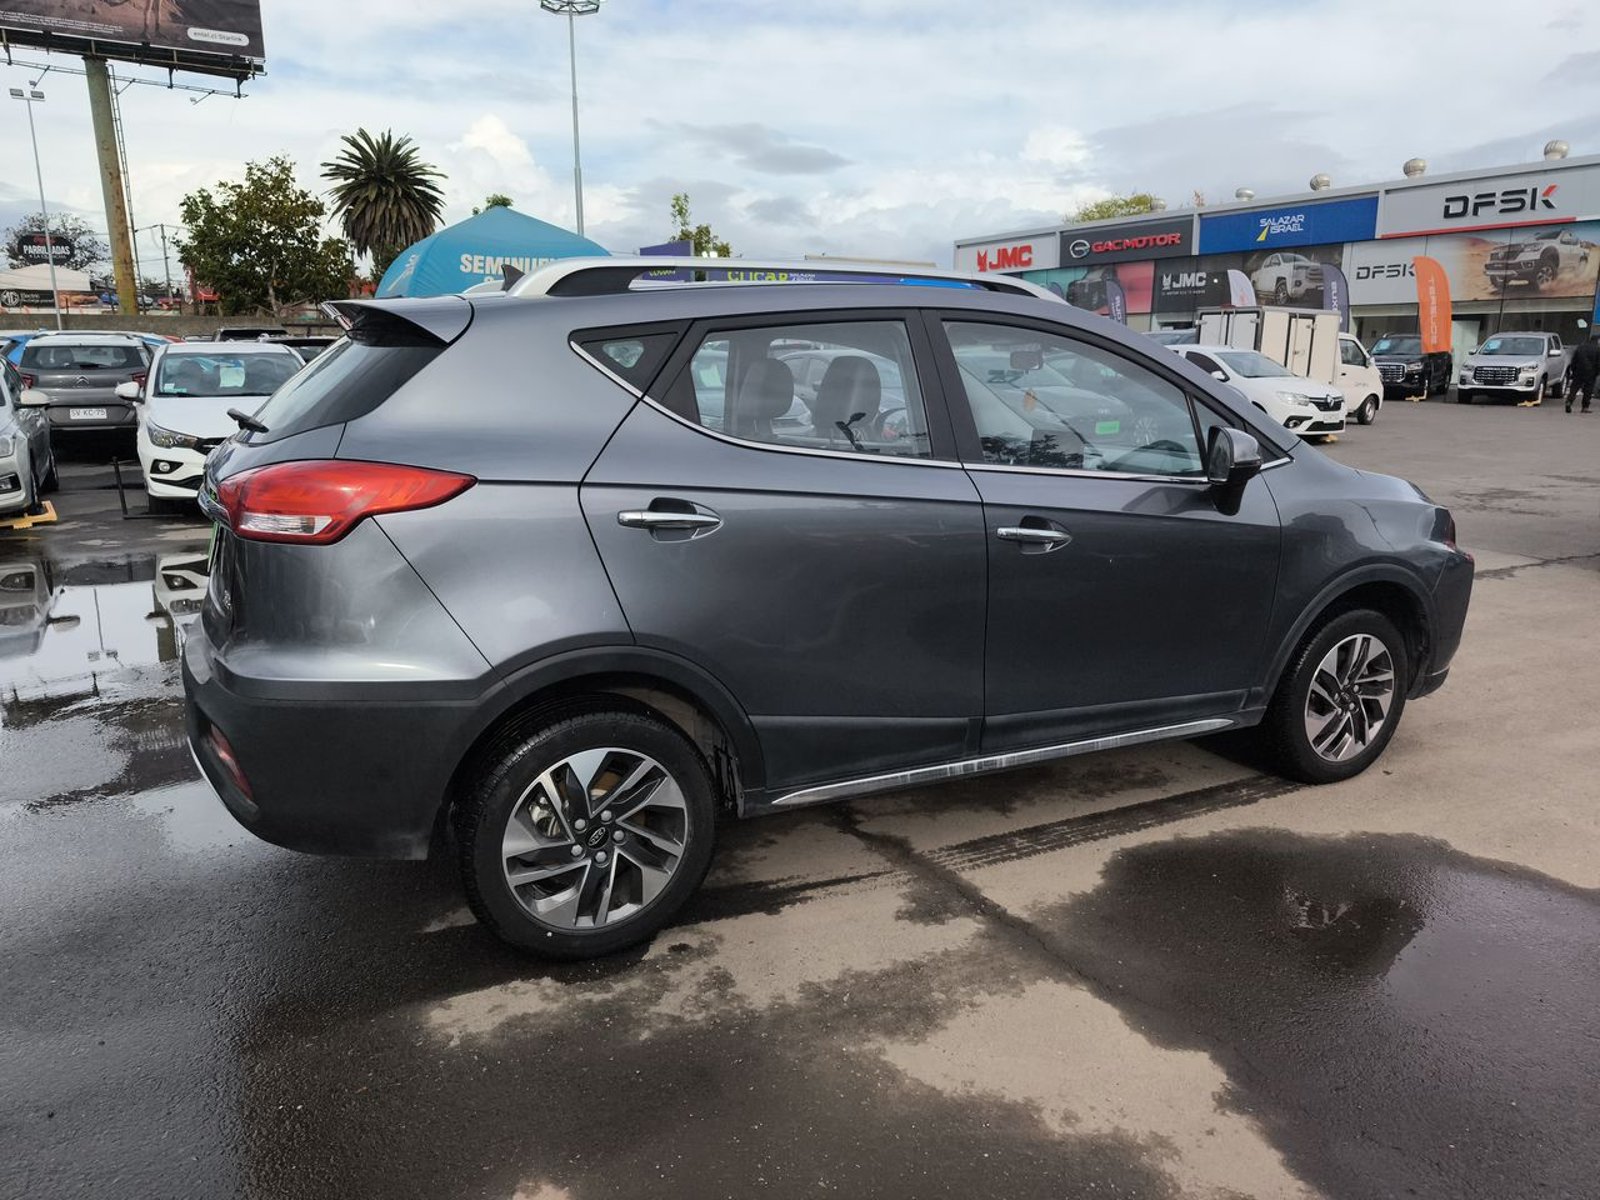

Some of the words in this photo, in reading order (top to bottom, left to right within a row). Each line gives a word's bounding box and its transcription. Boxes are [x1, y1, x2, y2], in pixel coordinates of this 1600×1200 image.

[1443, 184, 1559, 219] DFSK
[1259, 214, 1305, 227] SALAZAR
[1269, 223, 1304, 234] ISRAEL
[989, 245, 1032, 270] JMC
[1356, 263, 1416, 280] DFSK
[1172, 272, 1207, 288] JMC
